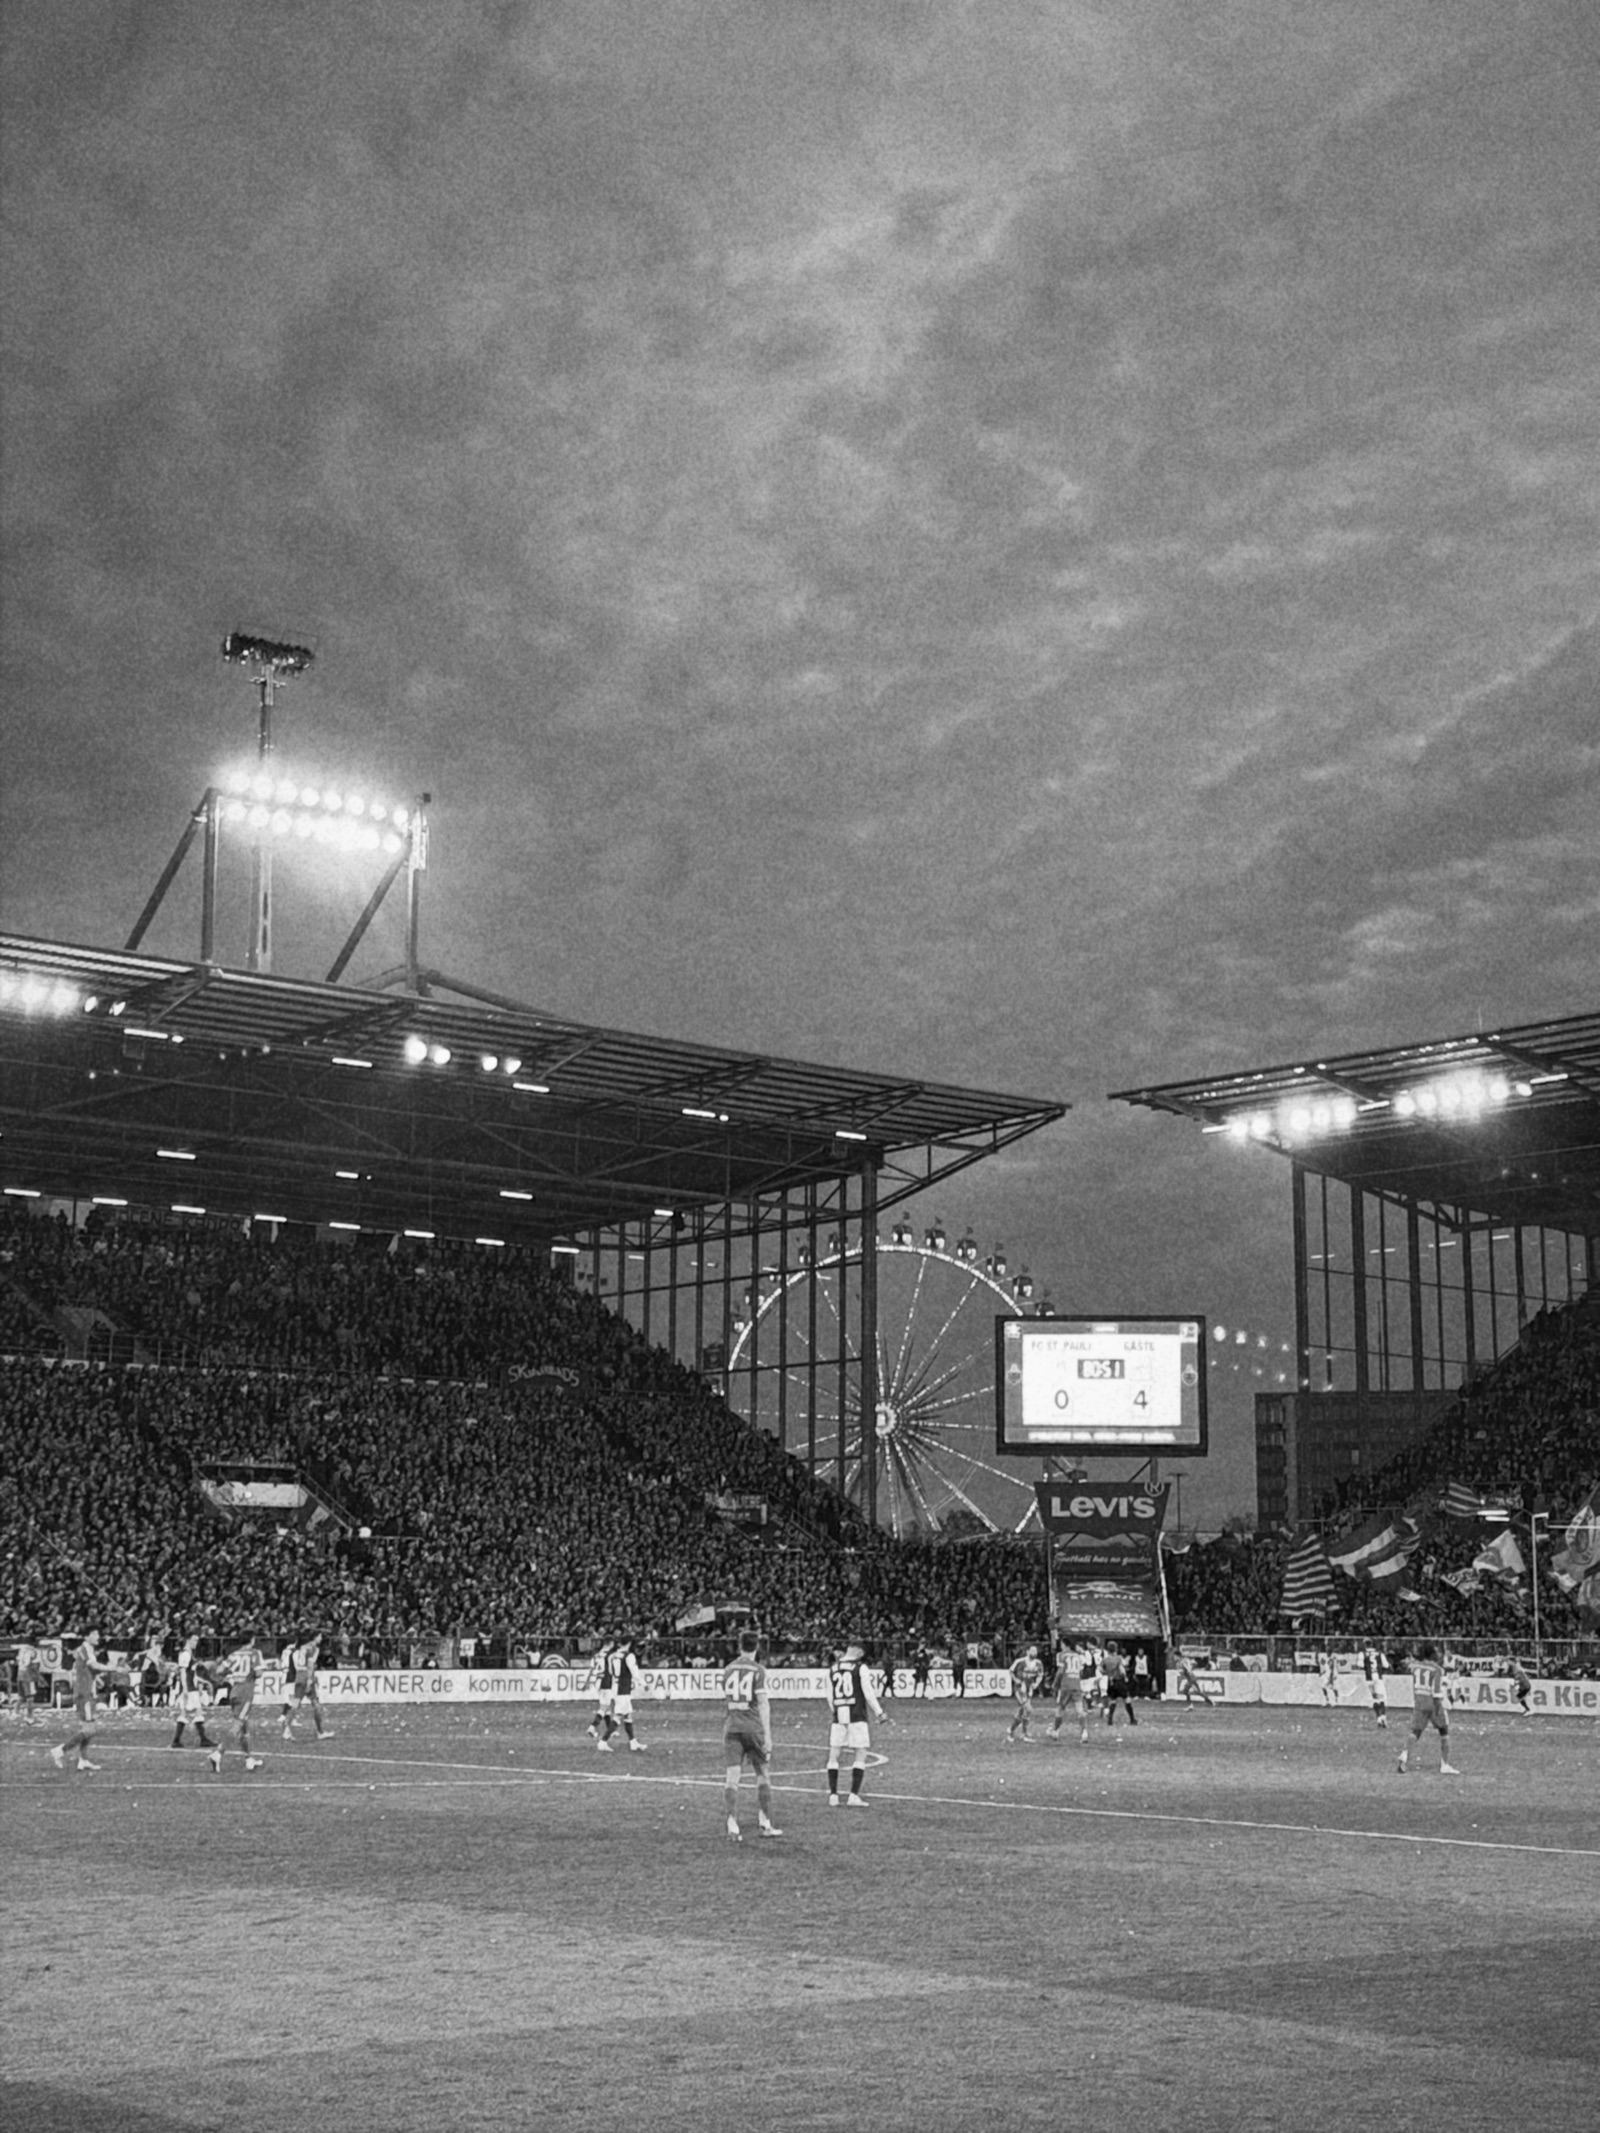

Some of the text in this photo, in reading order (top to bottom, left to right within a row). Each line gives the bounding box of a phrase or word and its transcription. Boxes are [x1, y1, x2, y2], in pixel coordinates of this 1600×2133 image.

[1055, 1389, 1069, 1409] 0
[1133, 1390, 1148, 1409] 4
[469, 1674, 523, 1692] komm
[725, 1670, 754, 1701] 44
[1413, 1668, 1432, 1686] 11
